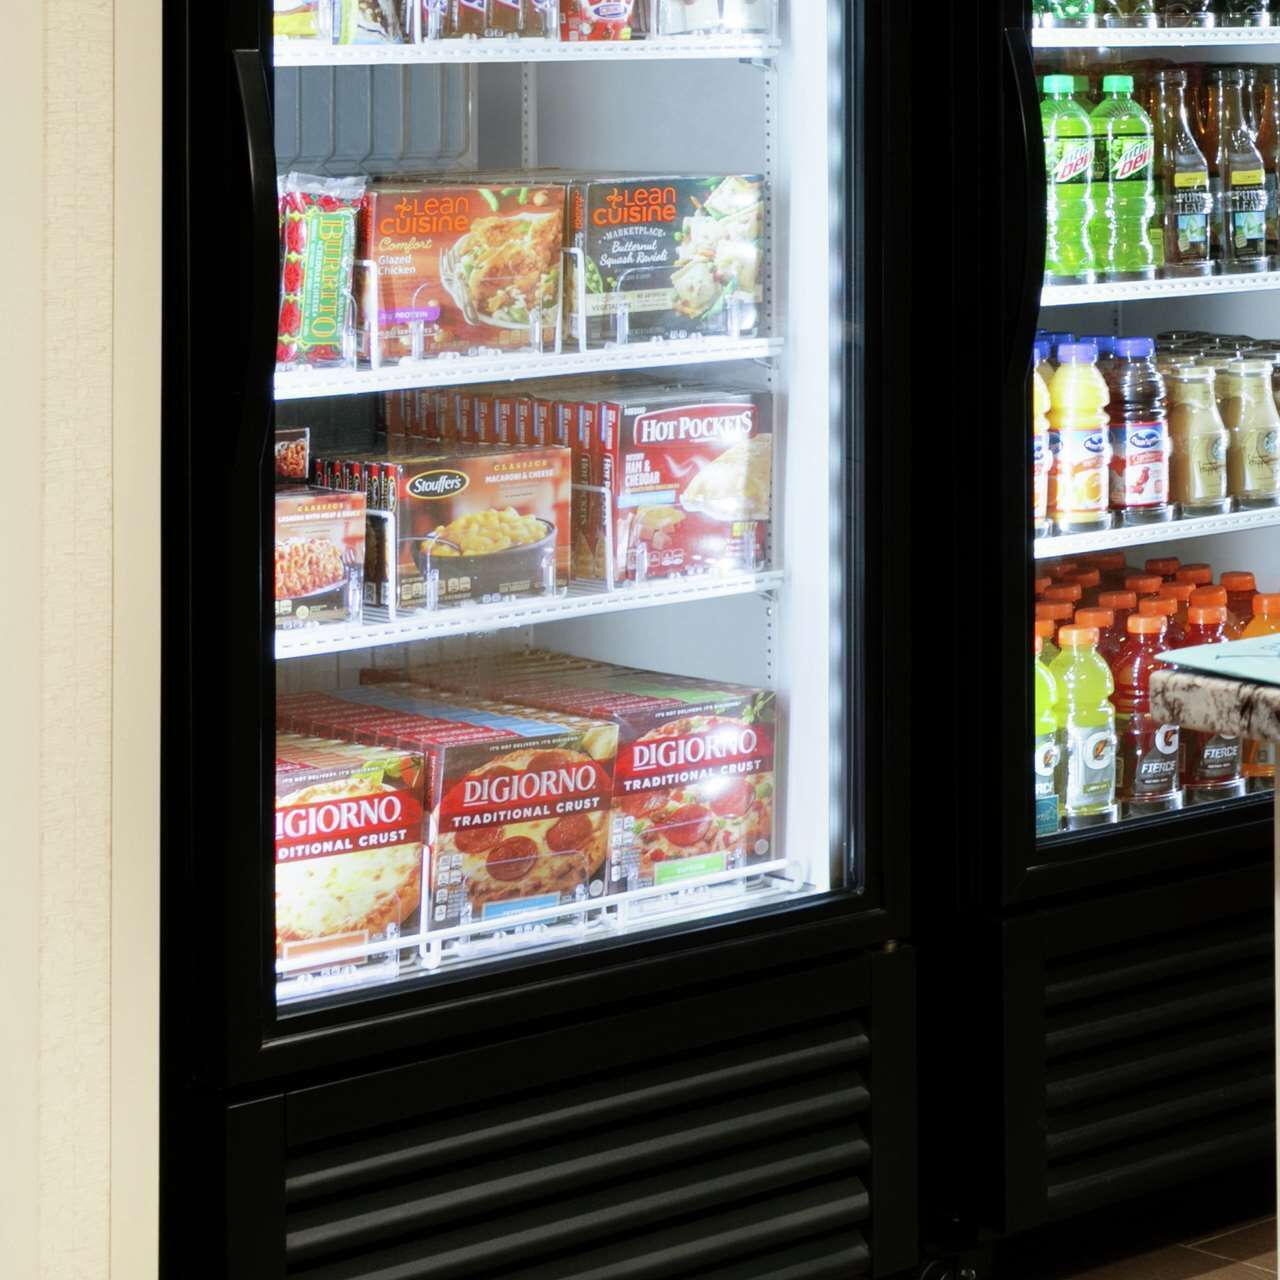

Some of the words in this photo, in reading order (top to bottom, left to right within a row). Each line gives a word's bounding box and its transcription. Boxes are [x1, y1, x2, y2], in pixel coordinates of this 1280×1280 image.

[414, 196, 469, 216] Lean
[624, 187, 677, 207] Lean
[379, 236, 433, 254] Comfort
[611, 240, 657, 254] Butternut
[379, 253, 413, 265] Glazed
[600, 253, 635, 269] Squash
[635, 249, 669, 264] Ravioli
[311, 217, 345, 338] BURRITO
[640, 419, 678, 444] HOT
[413, 474, 462, 494] Stouffer's
[1203, 745, 1239, 759] FIERCE
[623, 768, 714, 792] TRADITIONAL
[720, 759, 762, 776] CRUST
[1141, 759, 1177, 774] FIERCE
[463, 765, 597, 807] DIGIORNO
[452, 805, 551, 827] TRADITIONAL
[555, 797, 600, 813] CRUST
[278, 835, 353, 860] DITIONAL
[358, 829, 407, 848] CRUST
